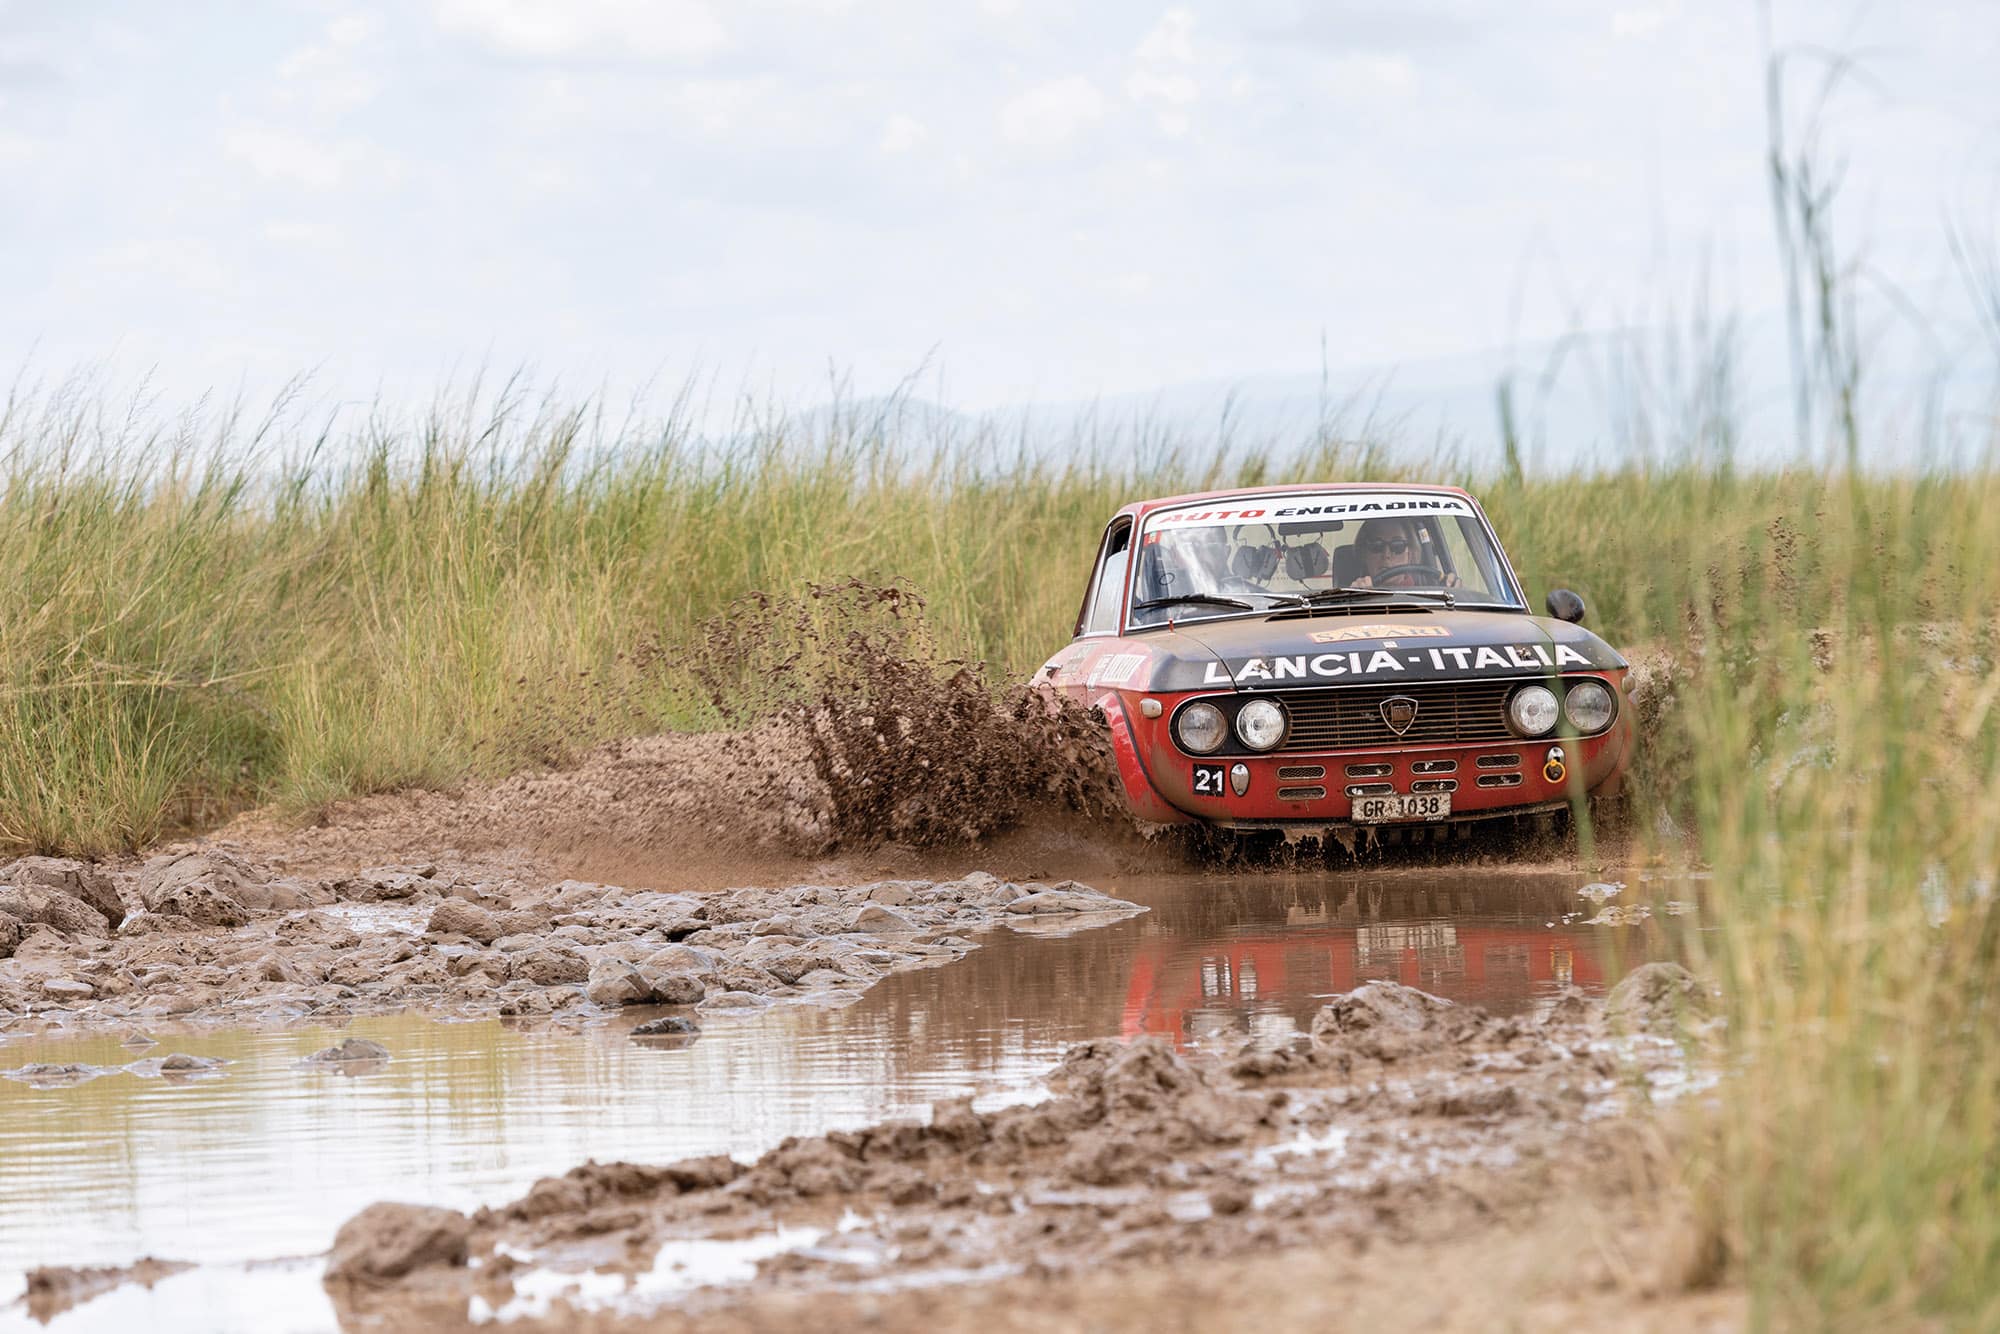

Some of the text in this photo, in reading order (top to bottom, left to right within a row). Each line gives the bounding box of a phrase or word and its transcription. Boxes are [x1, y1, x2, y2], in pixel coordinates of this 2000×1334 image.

[1157, 501, 1464, 525] AUTO ENGIADINA
[1195, 769, 1223, 792] 21
[1363, 796, 1440, 818] GR 1038
